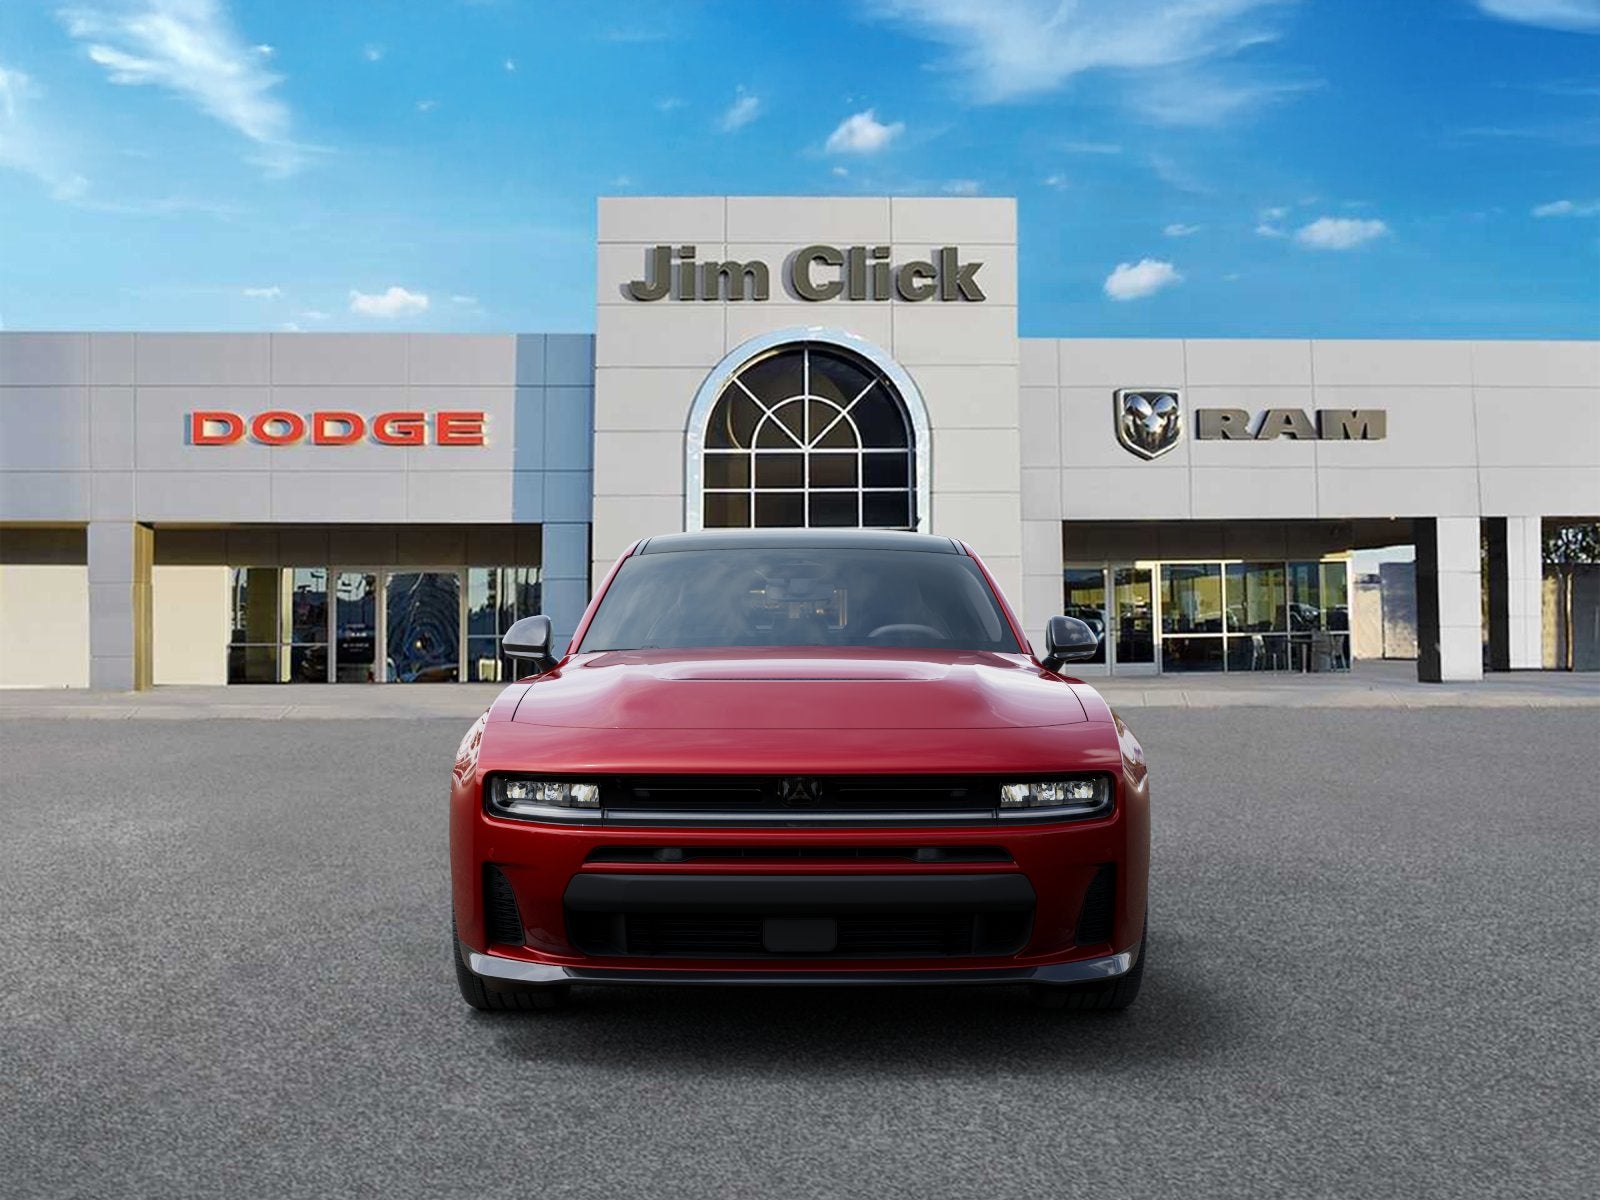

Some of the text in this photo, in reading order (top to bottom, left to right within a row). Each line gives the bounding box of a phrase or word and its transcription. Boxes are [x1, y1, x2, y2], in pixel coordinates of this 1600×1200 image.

[629, 244, 986, 302] Jim Click
[190, 410, 486, 446] DODGE
[1195, 408, 1387, 440] RAM
